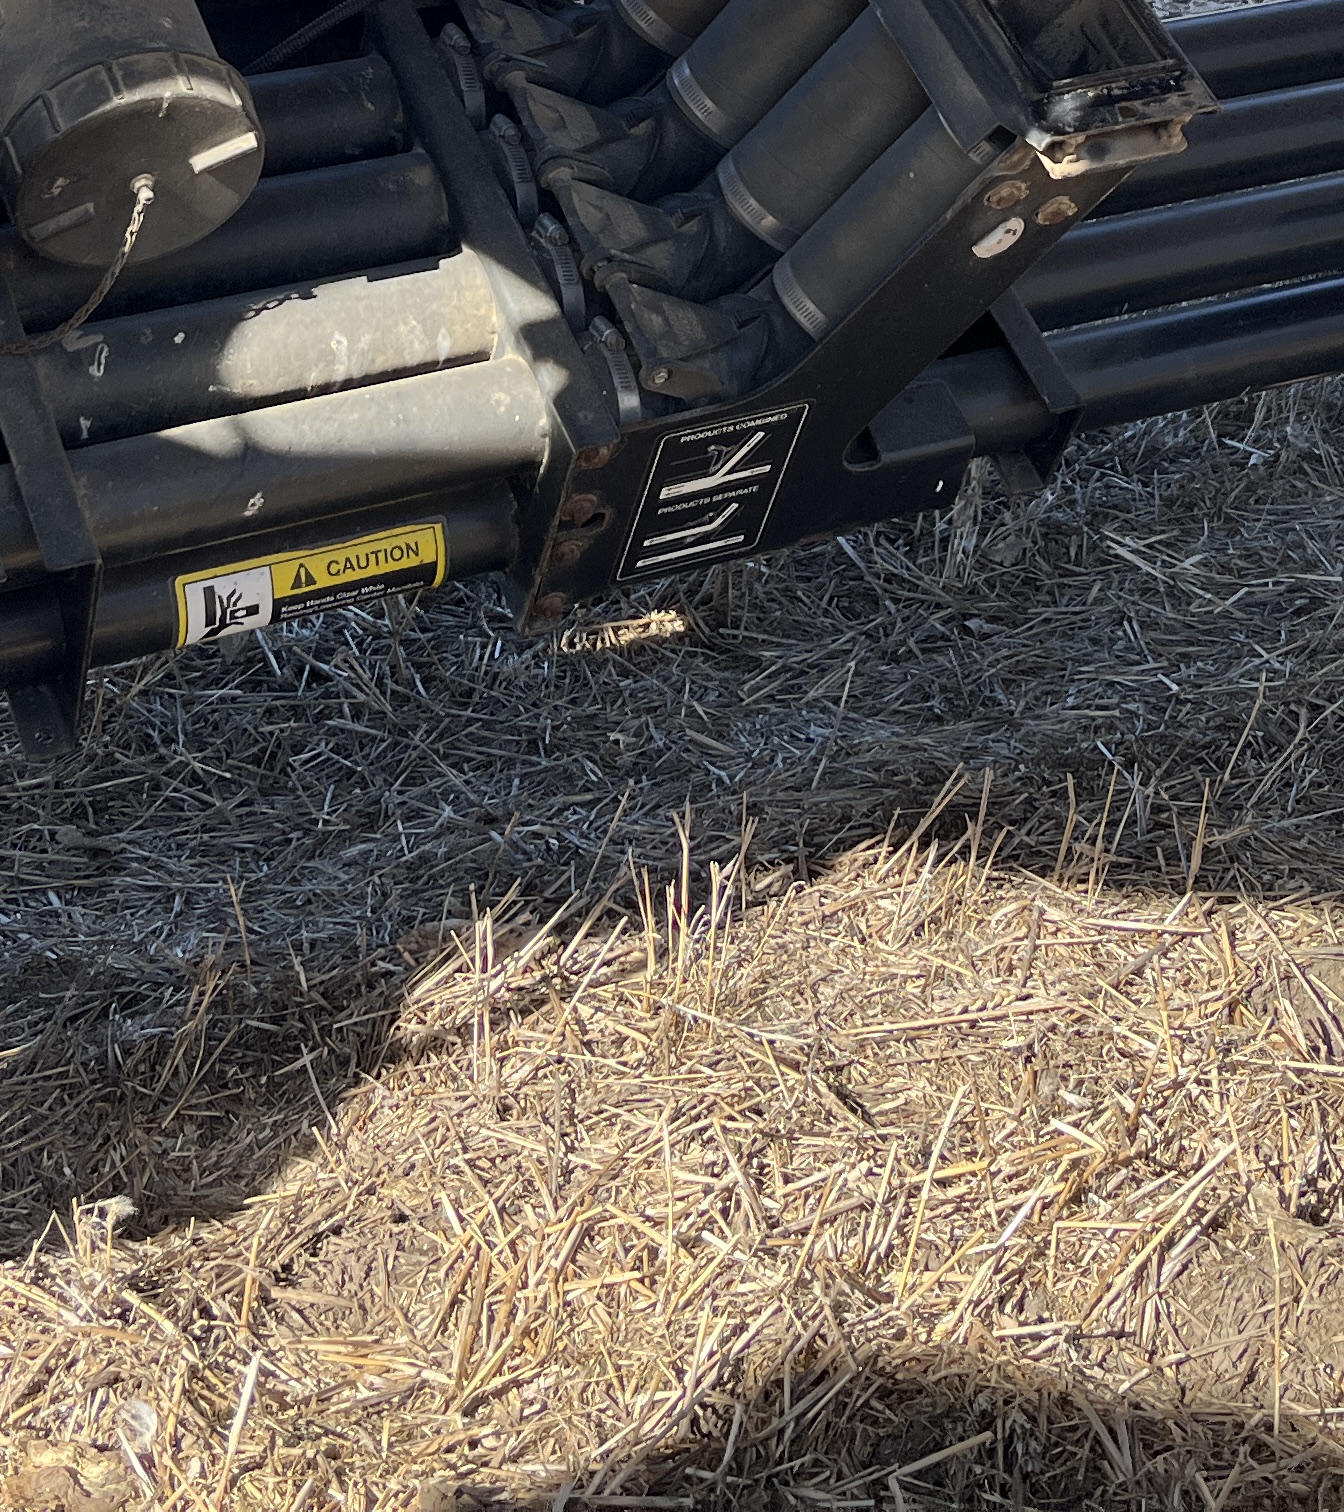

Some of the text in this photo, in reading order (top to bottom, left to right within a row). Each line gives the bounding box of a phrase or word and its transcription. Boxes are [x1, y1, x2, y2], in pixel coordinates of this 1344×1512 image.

[680, 413, 788, 443] PRODUCTS COMBINED
[657, 484, 760, 515] PRODUCTS SEPARATE
[326, 540, 420, 577] CAUTION
[281, 603, 305, 614] Keep
[306, 595, 334, 607] Hands
[336, 589, 360, 600] Clear
